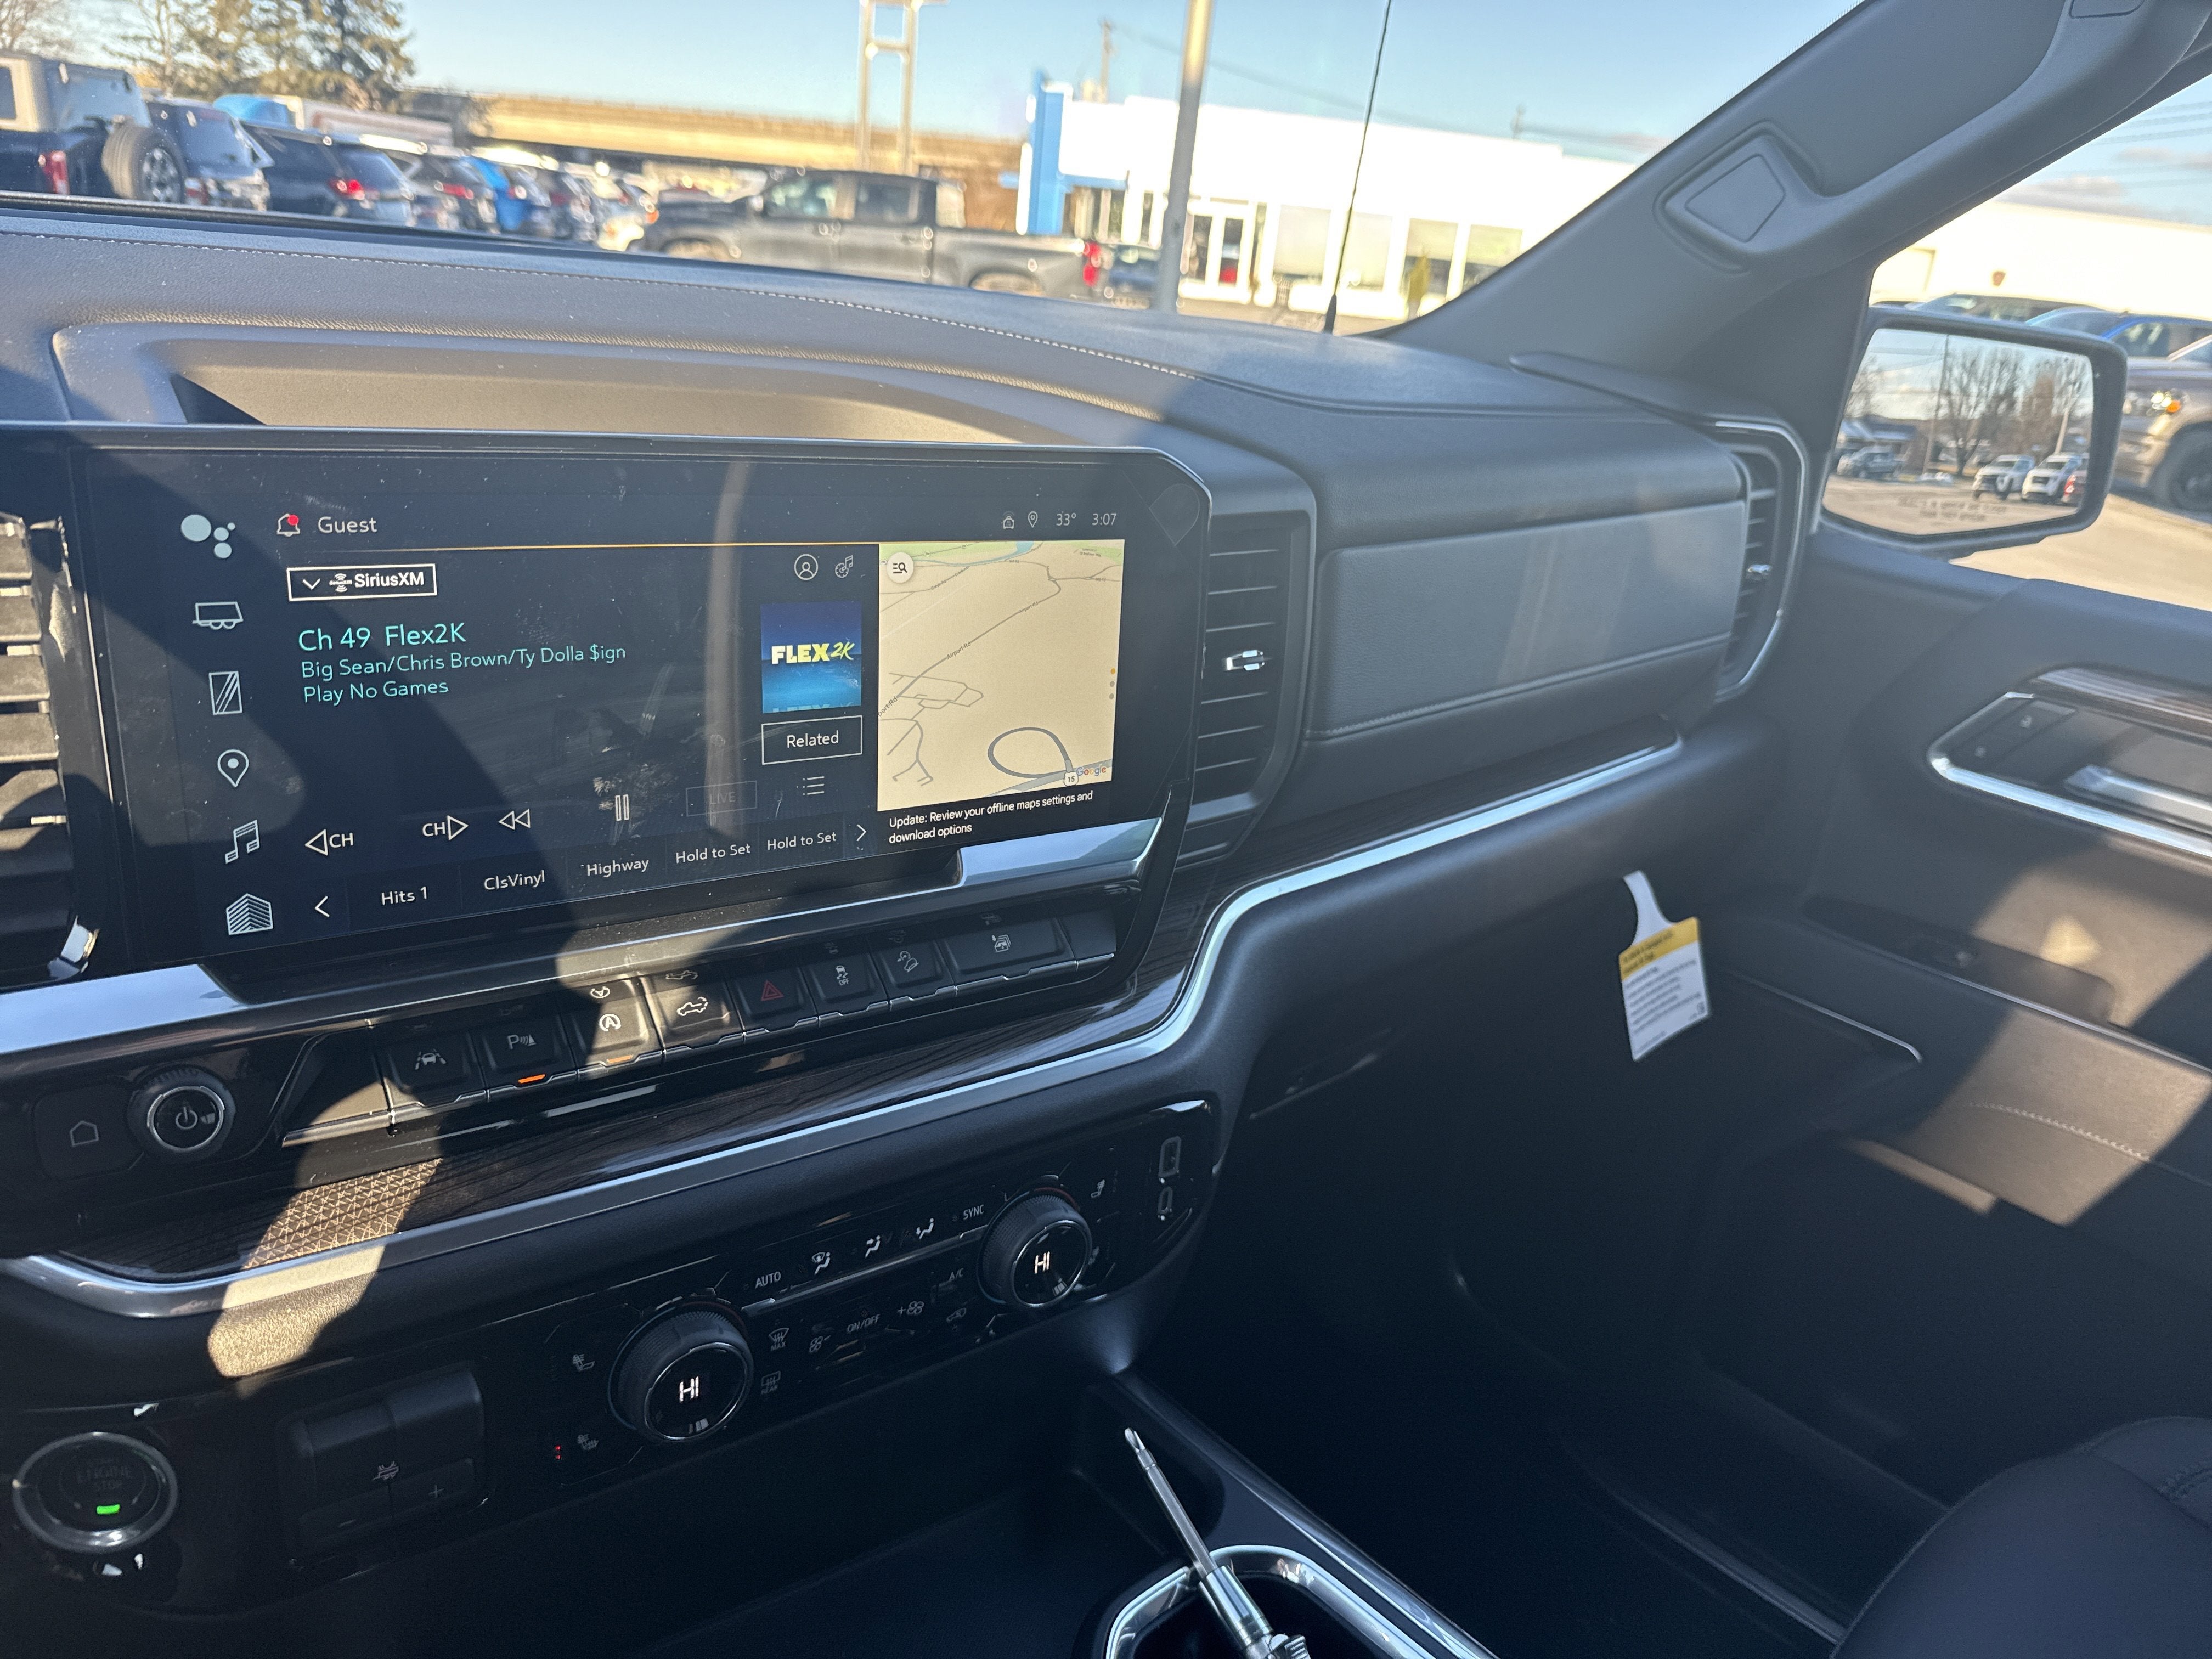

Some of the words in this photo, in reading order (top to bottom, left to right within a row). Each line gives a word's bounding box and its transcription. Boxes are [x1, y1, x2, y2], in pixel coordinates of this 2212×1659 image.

[318, 516, 377, 534] Guest
[1092, 513, 1117, 526] 3:07
[354, 572, 424, 588] SiriusXM
[298, 628, 332, 651] Ch
[340, 627, 371, 648] 49
[386, 623, 466, 646] Flex2K
[771, 643, 830, 664] FLEX
[830, 641, 855, 661] 2K
[947, 646, 964, 660] Airport
[963, 641, 971, 649] Rd
[302, 661, 333, 682] Big
[340, 654, 445, 675] Sean/Chris
[451, 648, 535, 669] Brown/Ty
[541, 646, 584, 663] Dolla
[590, 644, 625, 664] $ign
[304, 686, 343, 706] Play
[351, 683, 377, 699] No
[383, 681, 449, 697] Games
[888, 696, 898, 705] Rd
[787, 730, 839, 748] Related
[1076, 765, 1107, 776] Google
[709, 790, 736, 806] LIVE
[889, 815, 928, 828] Update:
[930, 809, 963, 822] Review
[964, 808, 985, 821] your
[986, 801, 1015, 815] offline
[1017, 799, 1040, 812] maps
[1042, 794, 1075, 808] settings
[1077, 791, 1093, 802] and
[422, 822, 445, 837] CH
[889, 830, 935, 844] download
[937, 823, 972, 837] options
[329, 833, 354, 848] CH
[768, 835, 797, 851] Hold
[800, 834, 814, 846] to
[817, 832, 837, 844] Set
[676, 847, 708, 864] Hold
[712, 846, 726, 859] to
[730, 843, 751, 856] Set
[587, 857, 649, 878] Highway
[484, 870, 545, 890] ClsVinyl
[382, 889, 415, 905] Hits
[420, 886, 428, 900] 1
[507, 1035, 519, 1049] P
[963, 1205, 985, 1220] SYNC
[1034, 1251, 1051, 1274] HI
[755, 1271, 782, 1289] AUTO
[949, 1268, 964, 1282] A/C
[847, 1314, 881, 1334] ON/OFF
[770, 1341, 786, 1351] MAX
[679, 1376, 699, 1403] HI
